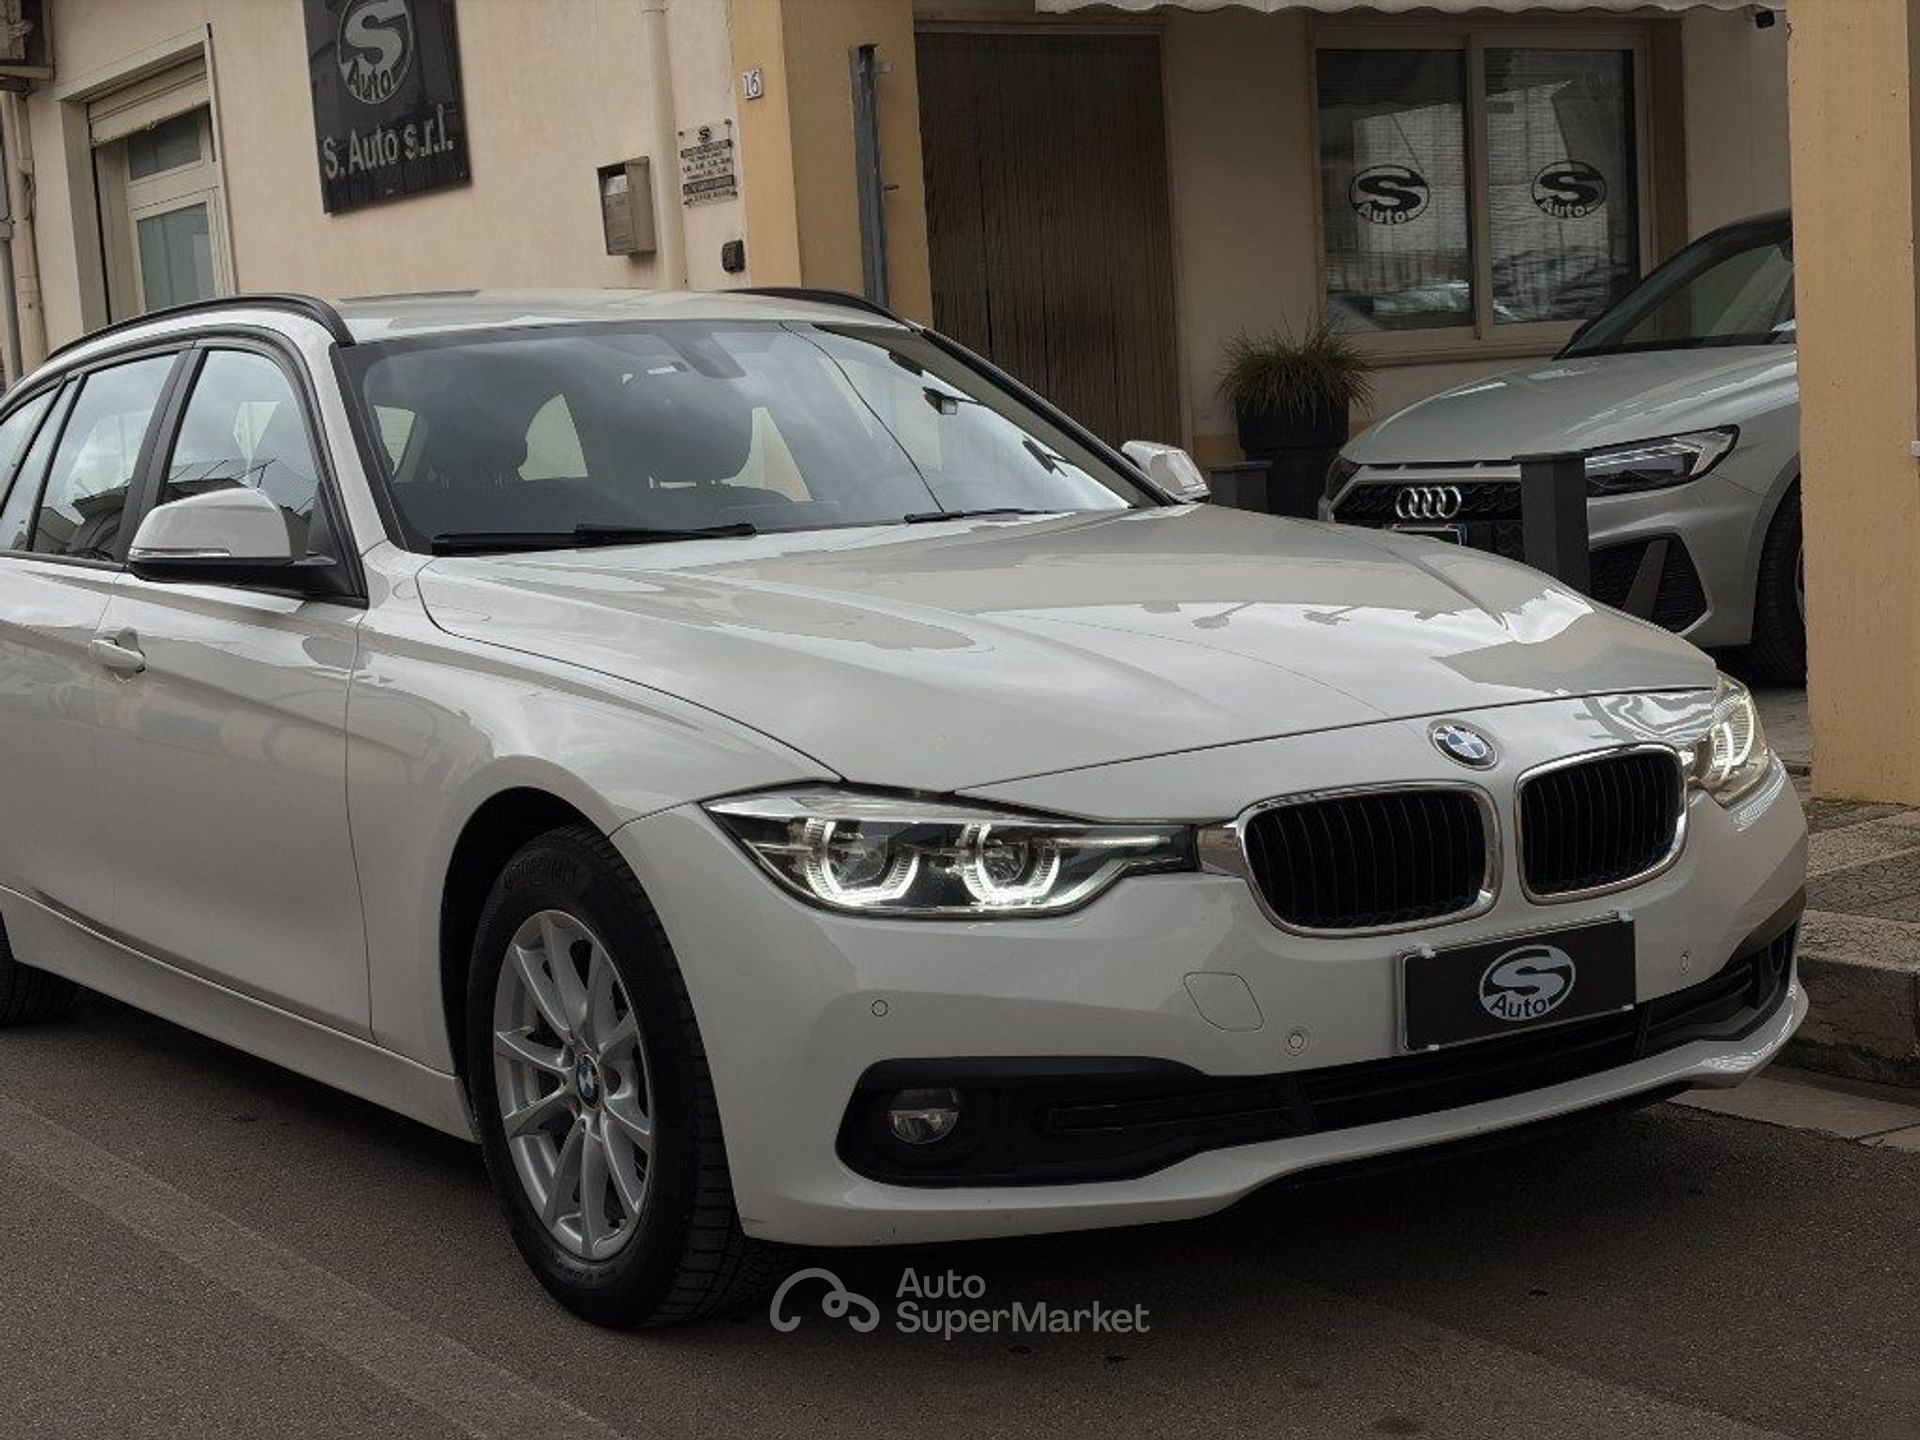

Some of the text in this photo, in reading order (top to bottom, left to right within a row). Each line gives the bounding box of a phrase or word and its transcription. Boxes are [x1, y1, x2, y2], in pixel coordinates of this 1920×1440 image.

[344, 0, 408, 64] S
[348, 58, 393, 101] Auto
[743, 70, 761, 97] 16
[323, 103, 454, 180] S. Auto s.r.l.
[1355, 168, 1428, 210] S
[1538, 166, 1603, 202] S
[1357, 202, 1408, 225] Auto
[1541, 198, 1585, 218] Auto
[1486, 948, 1571, 1000] S
[1489, 994, 1548, 1019] Auto
